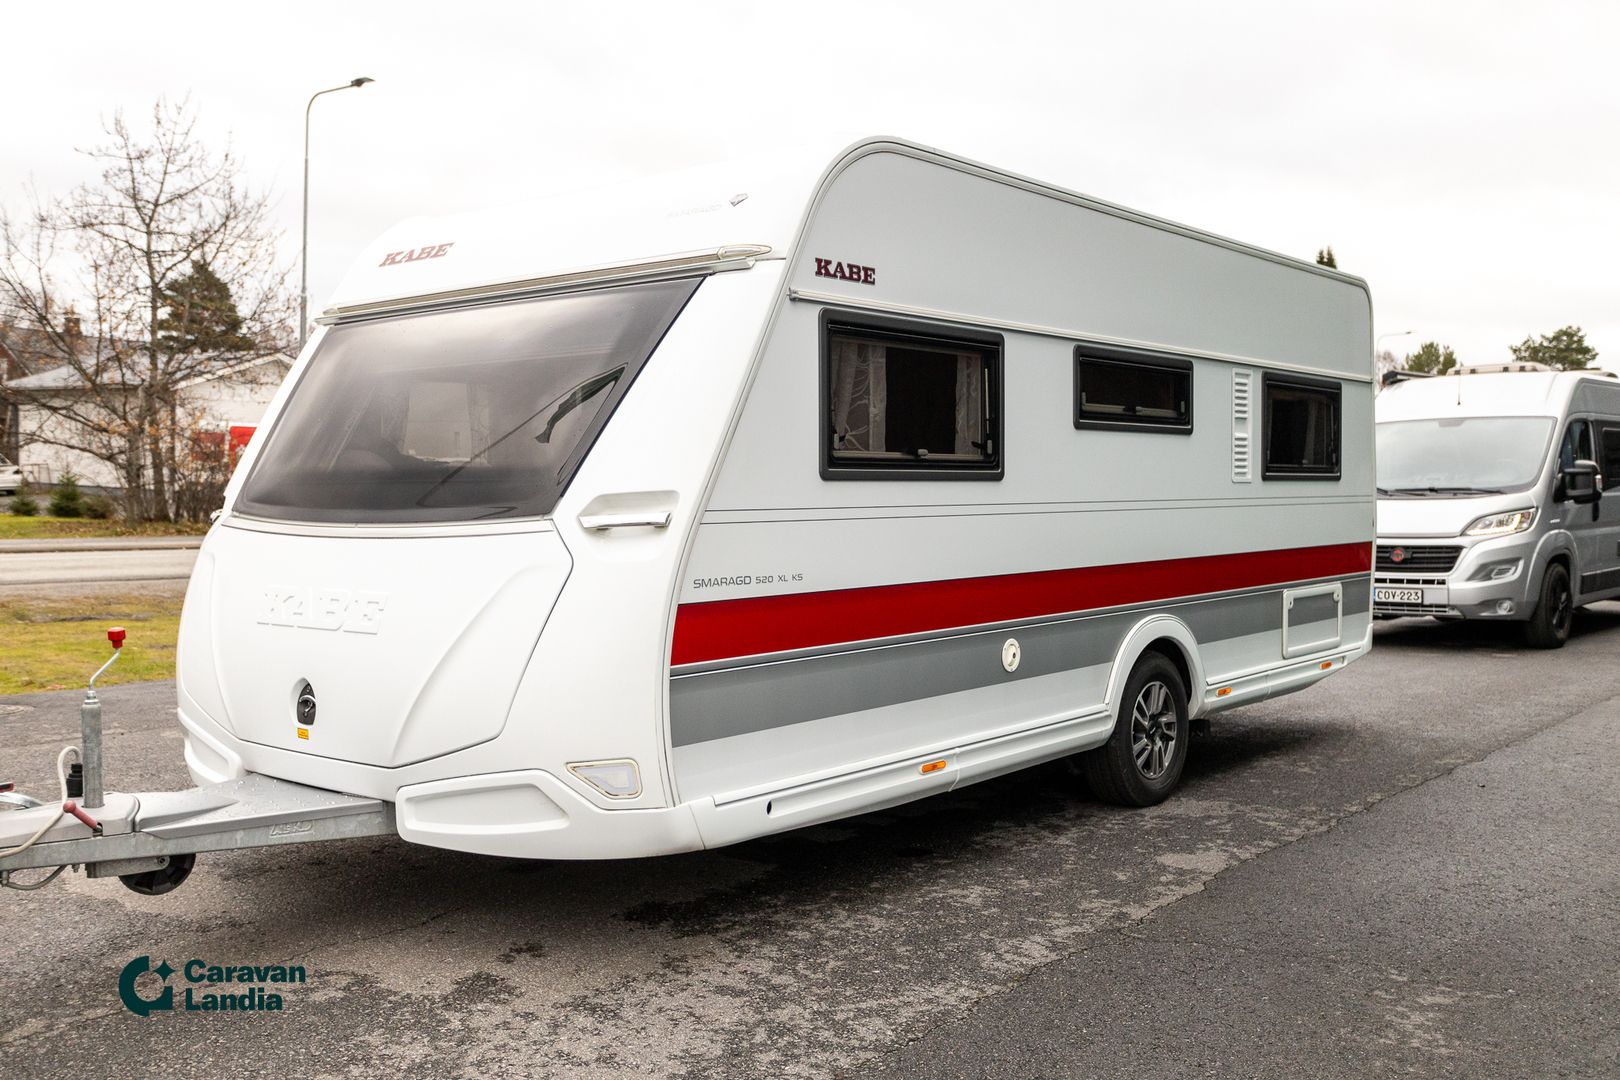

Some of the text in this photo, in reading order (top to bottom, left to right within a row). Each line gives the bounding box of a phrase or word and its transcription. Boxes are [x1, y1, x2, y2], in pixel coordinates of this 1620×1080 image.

[378, 242, 455, 267] KABE
[815, 257, 875, 286] KABE
[693, 572, 803, 589] SMARAGD 520 XL KS
[1377, 590, 1420, 601] COV-223
